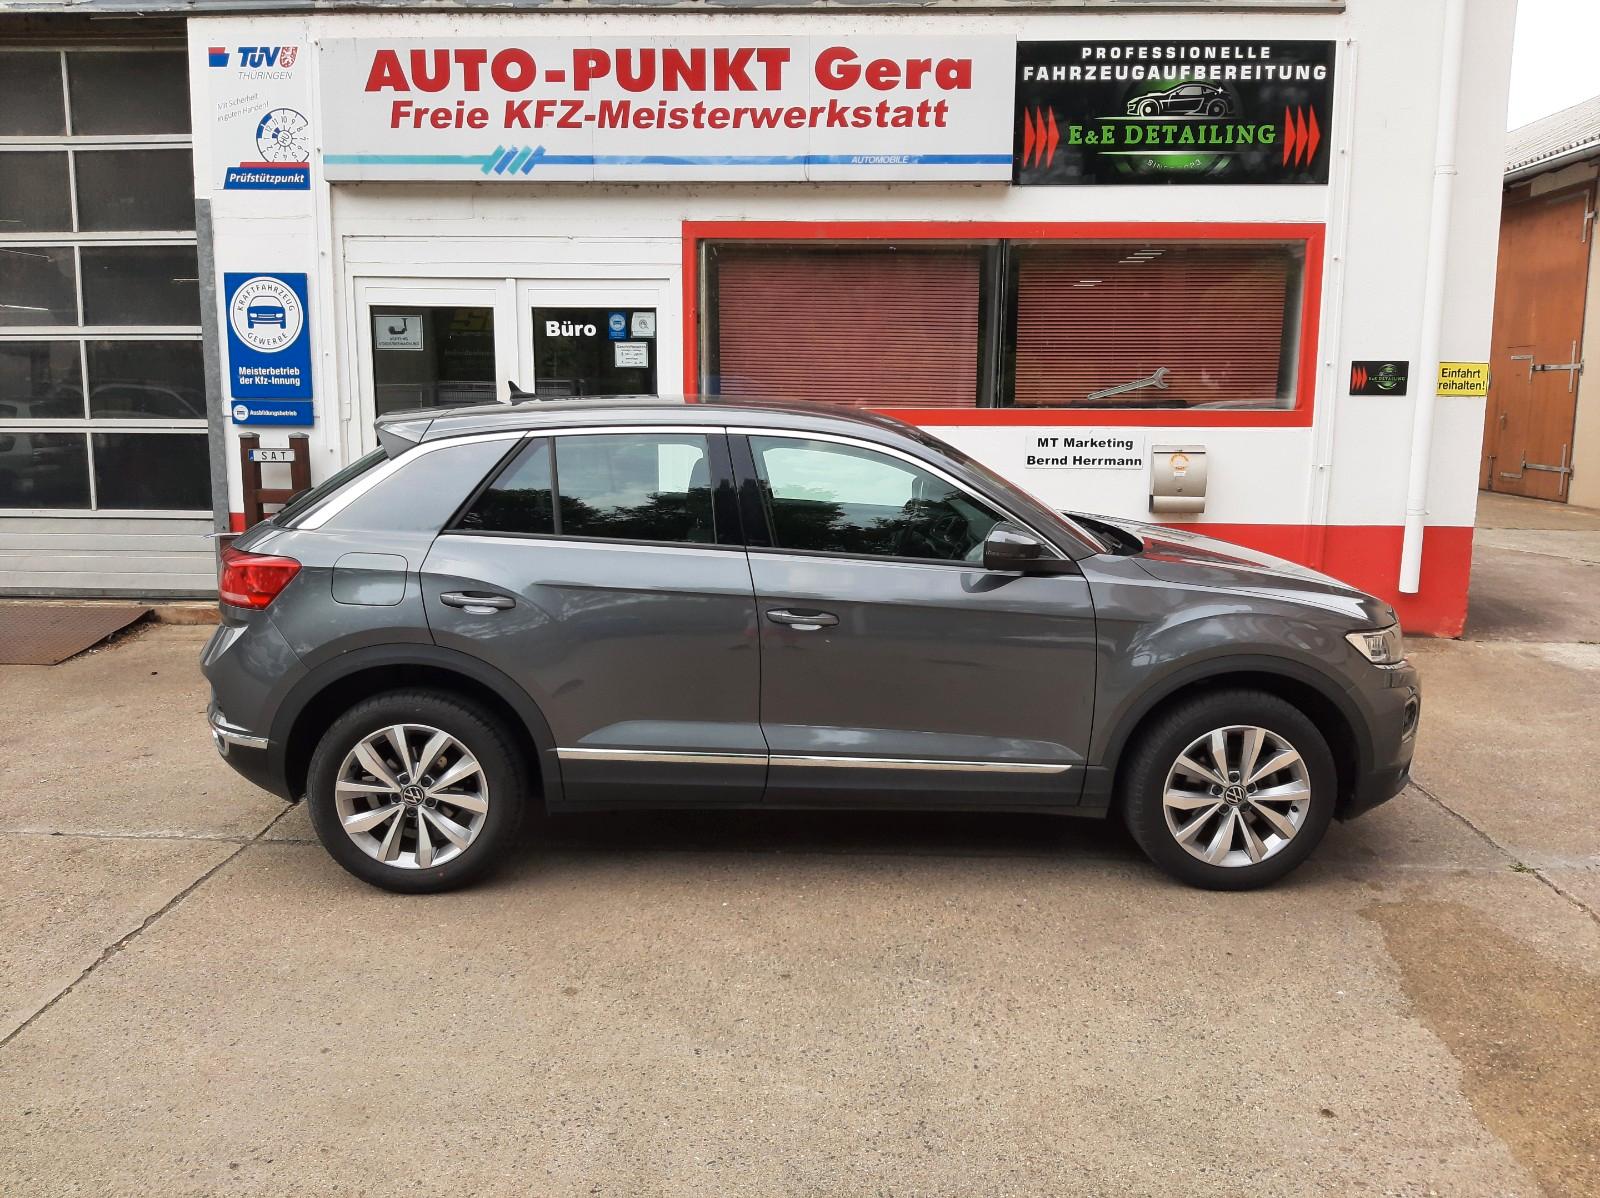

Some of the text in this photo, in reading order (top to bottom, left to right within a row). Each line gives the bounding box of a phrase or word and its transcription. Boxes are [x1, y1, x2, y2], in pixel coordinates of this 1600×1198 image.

[238, 46, 281, 69] TÜV
[1082, 46, 1271, 59] PROFESSIONELLE
[238, 70, 293, 80] THÜRINGEN
[365, 46, 972, 92] AUTO-PUNKT Gera
[1023, 65, 1328, 81] FAHRZEUGAUFBEREITUNG
[390, 98, 949, 129] Freie KFZ-Meisterwerkstatt
[1068, 124, 1276, 145] E&E DETAILING
[851, 155, 909, 164] AUTOMOBILE
[229, 172, 305, 184] Prüfstützpunkt
[236, 283, 296, 312] KRAFTFAHRZEUG
[546, 320, 597, 337] Büro
[247, 331, 289, 346] GEWERBE
[238, 366, 300, 376] Meisterbetrieb
[1441, 367, 1481, 379] Einfahrt
[239, 376, 301, 387] der Kfz-Innung
[1438, 380, 1486, 391] reihalten!
[1037, 437, 1134, 451] MT Marketing
[1027, 455, 1142, 466] Bernd Herrmann
